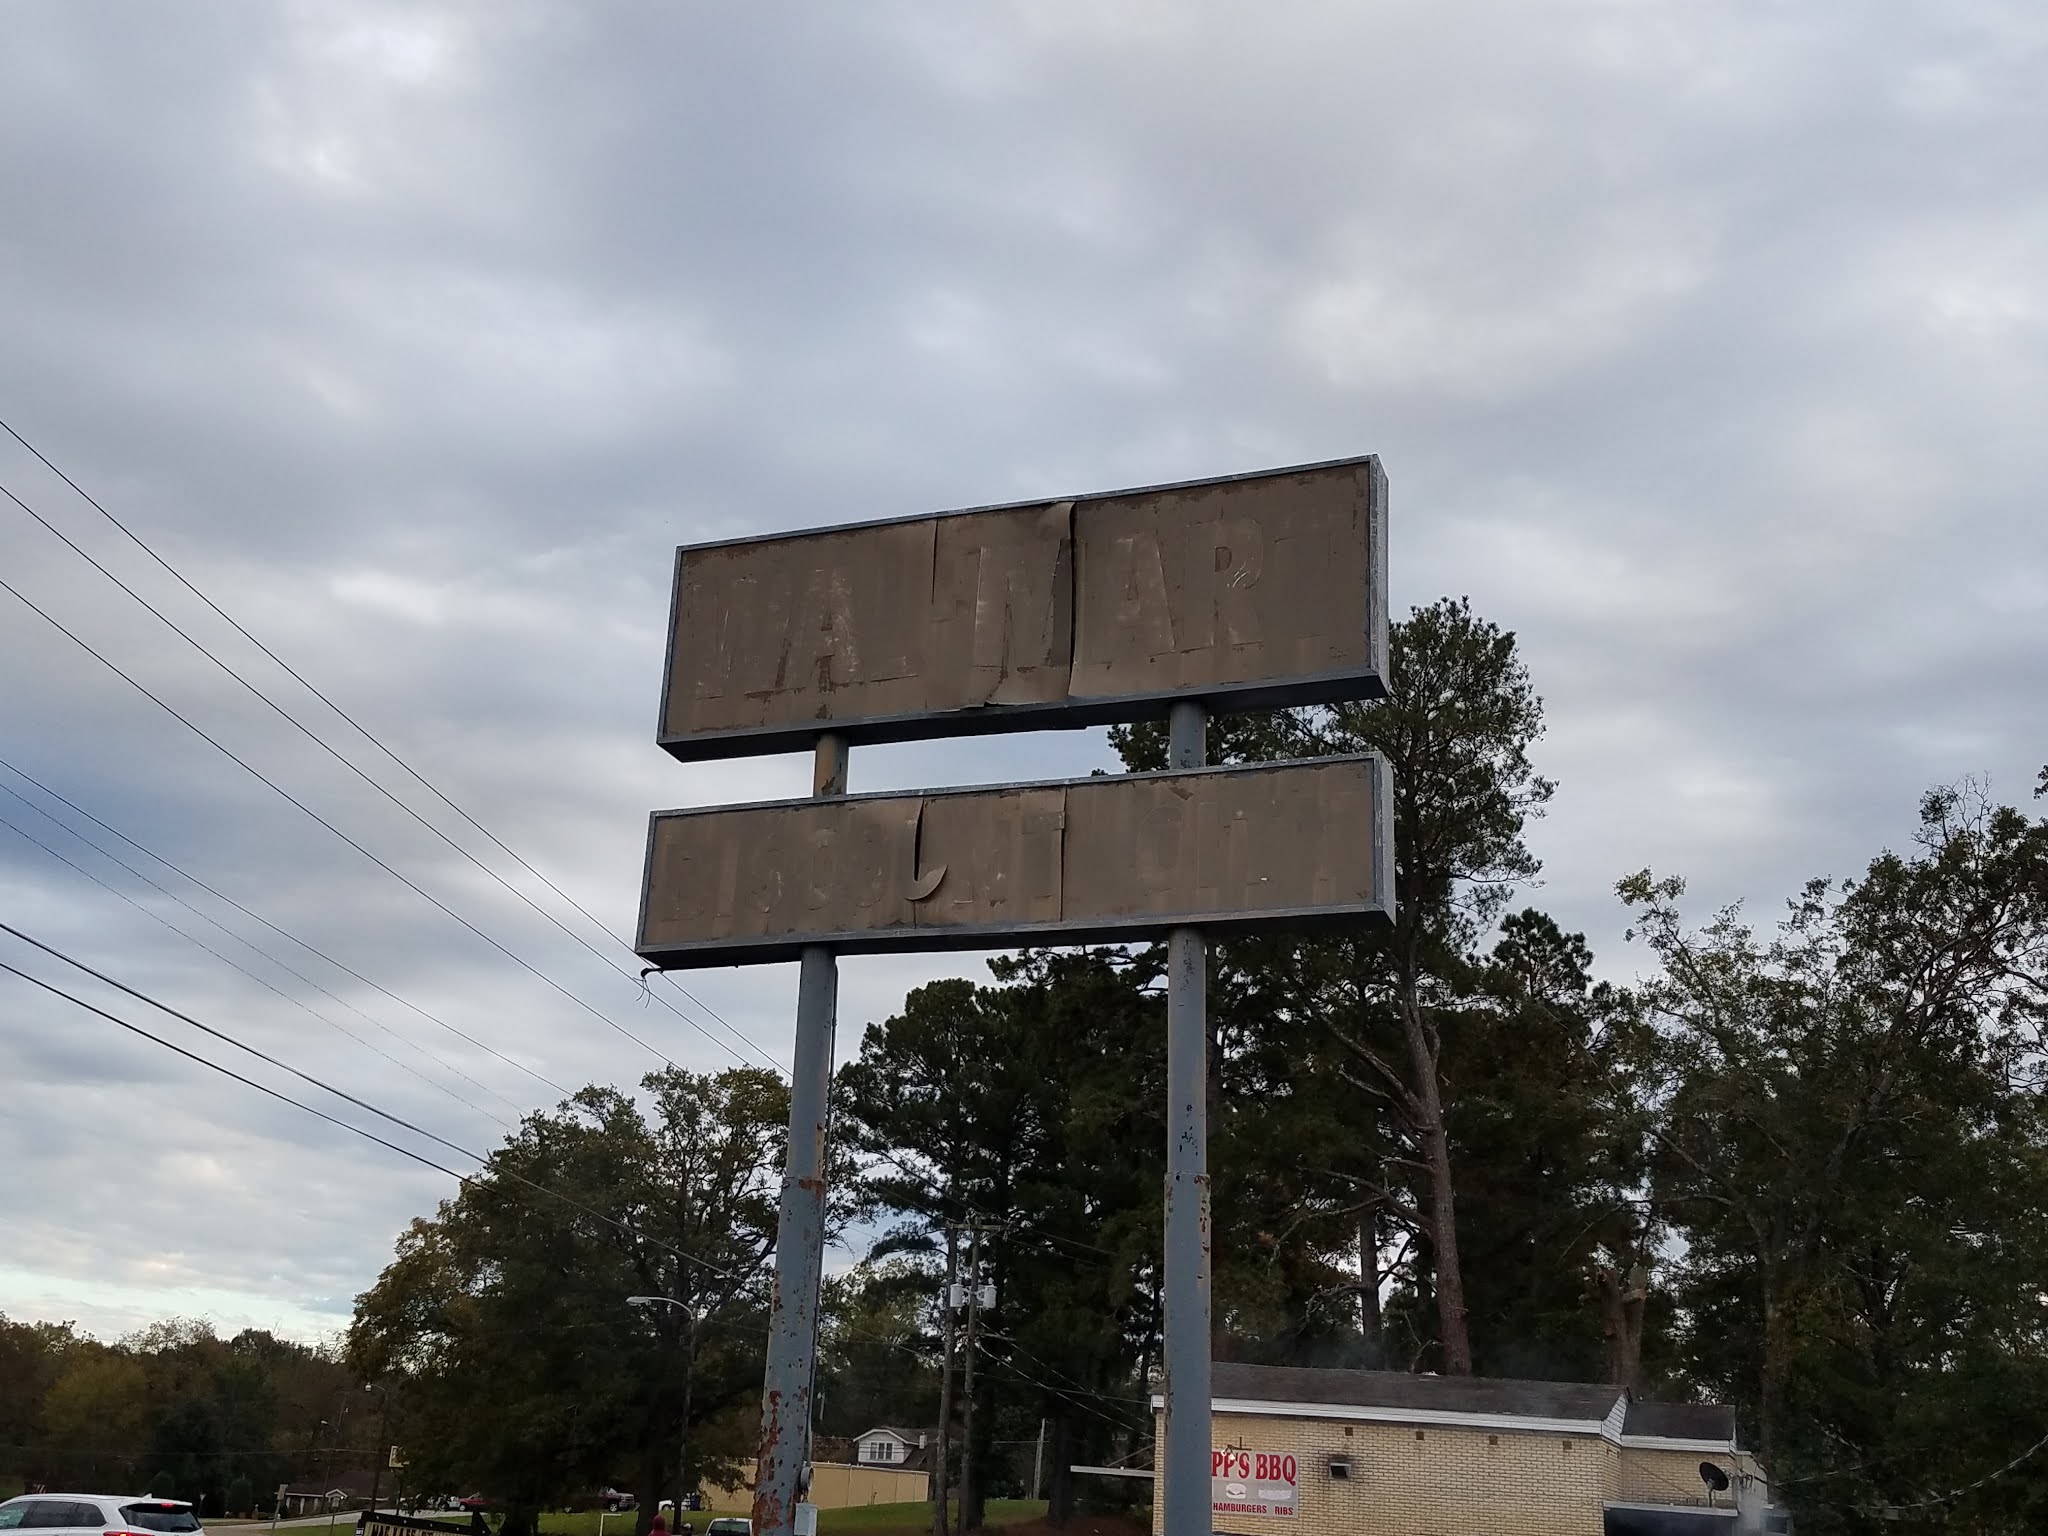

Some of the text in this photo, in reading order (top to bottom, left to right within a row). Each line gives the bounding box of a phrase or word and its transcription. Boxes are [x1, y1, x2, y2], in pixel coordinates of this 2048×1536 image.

[1255, 1453, 1297, 1487] BBQ
[1213, 1502, 1294, 1516] HAMBURGERS RIBS
